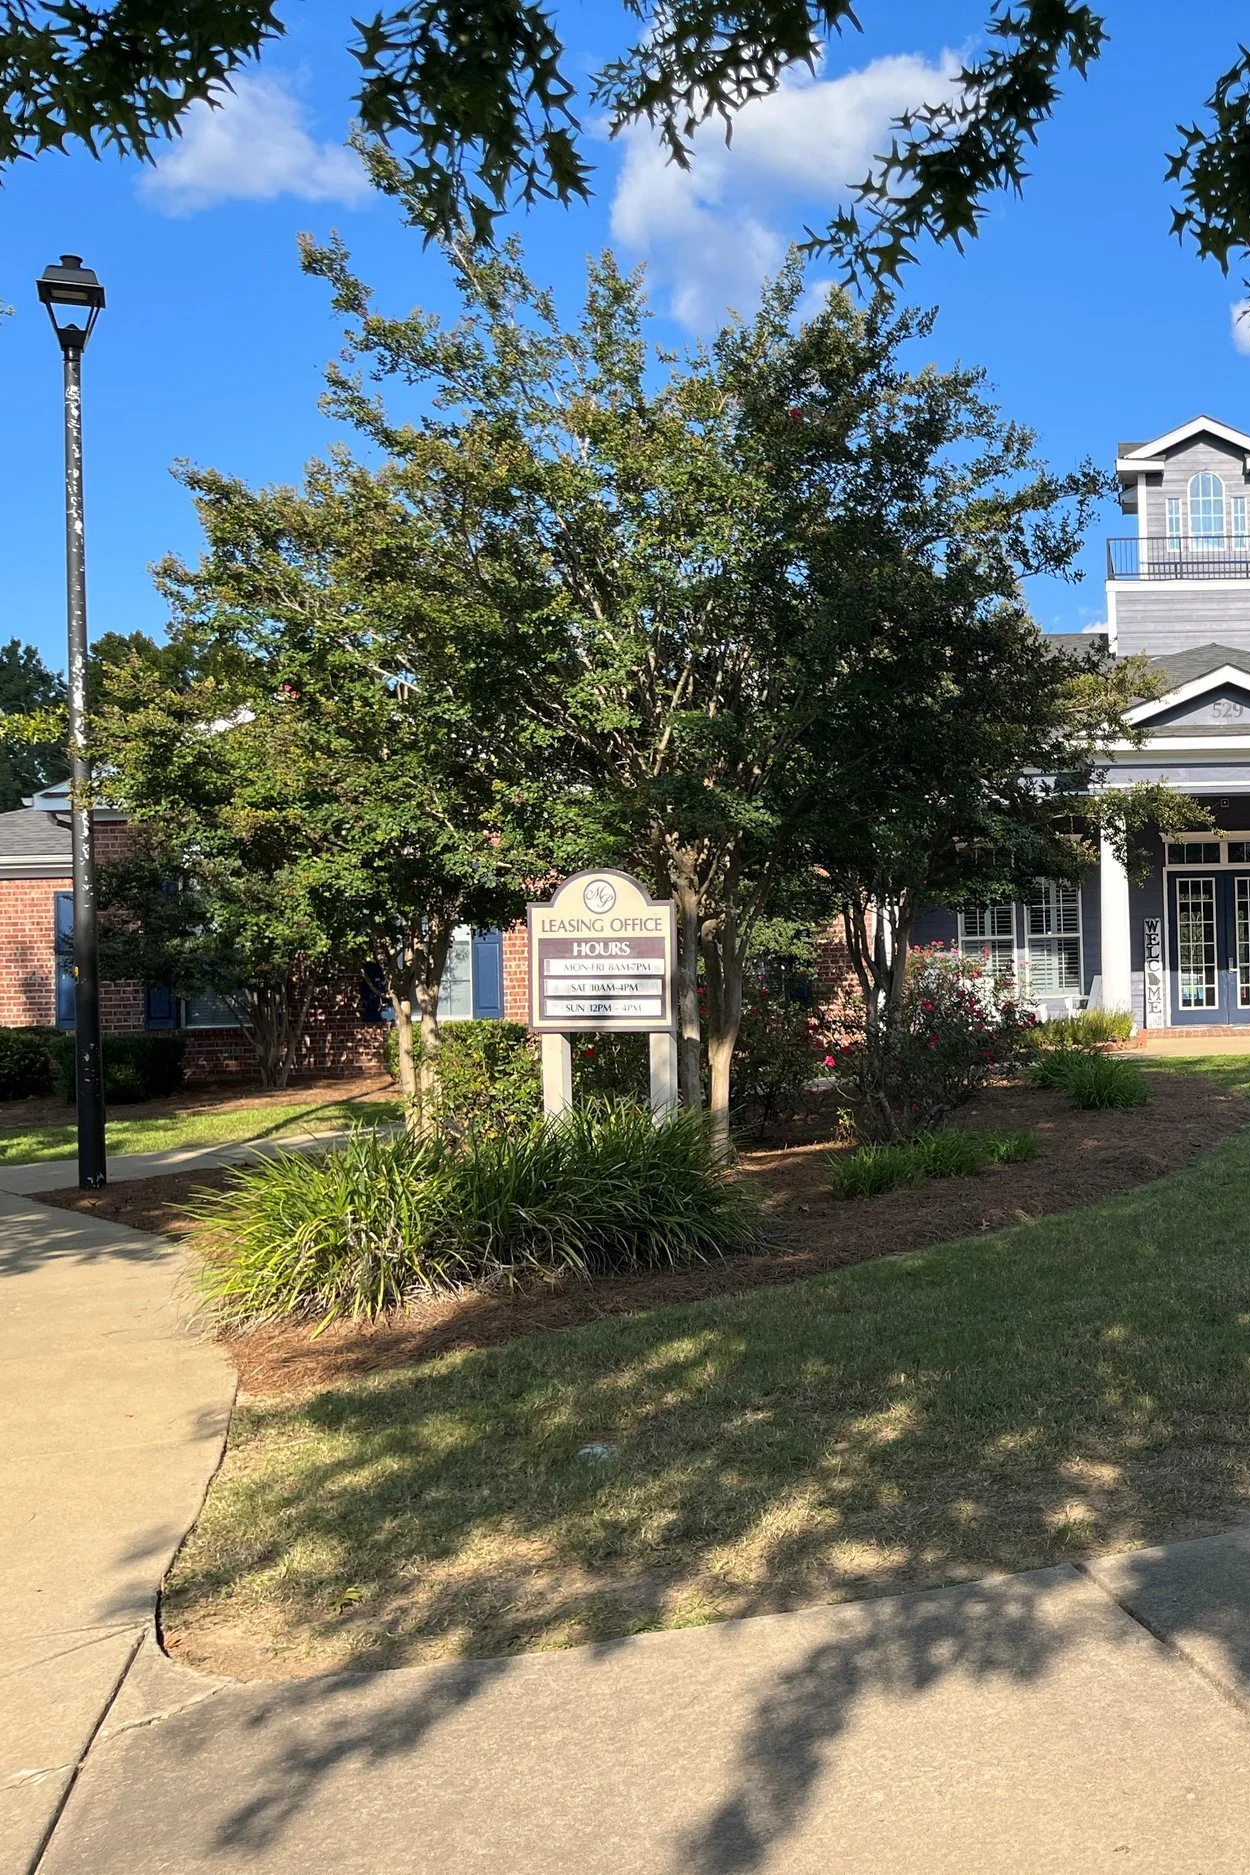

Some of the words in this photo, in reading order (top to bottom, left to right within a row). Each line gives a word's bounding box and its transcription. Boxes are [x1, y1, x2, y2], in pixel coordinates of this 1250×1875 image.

[1212, 702, 1244, 719] 529
[541, 918, 605, 933] LEASING
[610, 917, 663, 932] OFFICE
[573, 941, 631, 956] HOURS
[563, 962, 605, 972] MON-FRI
[571, 983, 586, 992] SAT
[591, 983, 639, 992] 10AM-4PM
[565, 1004, 585, 1012] SUN
[589, 1004, 612, 1012] 12PM
[622, 1004, 642, 1012] 4PM
